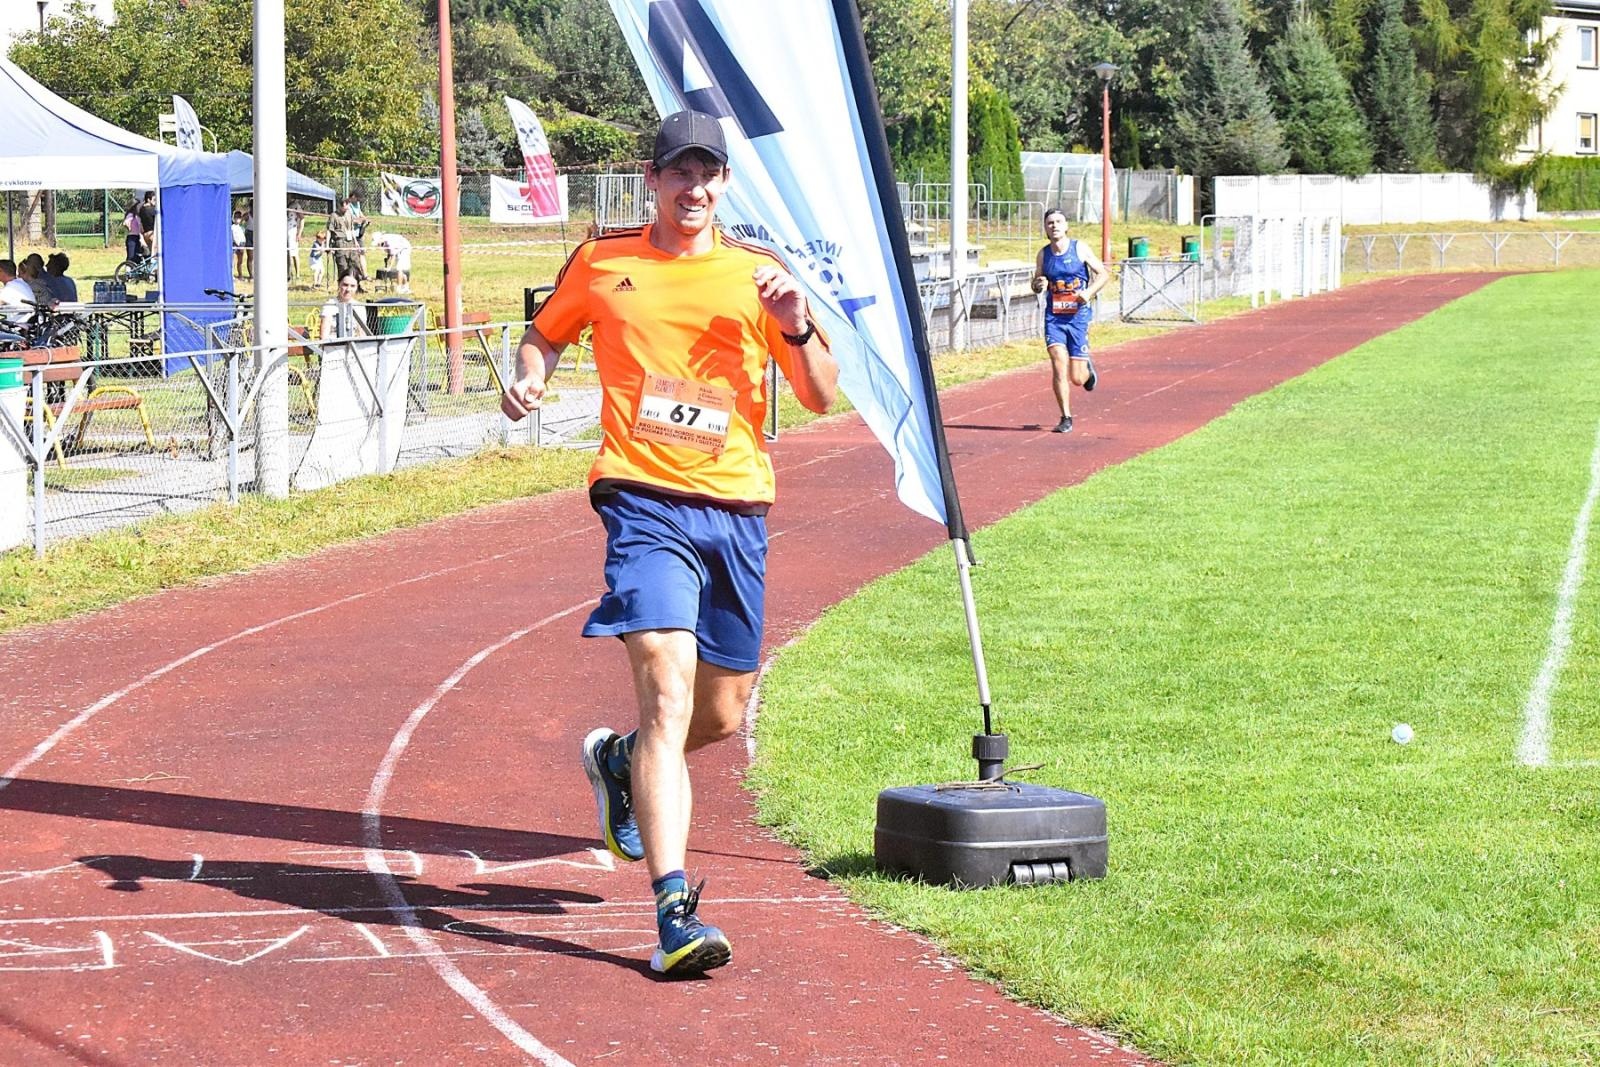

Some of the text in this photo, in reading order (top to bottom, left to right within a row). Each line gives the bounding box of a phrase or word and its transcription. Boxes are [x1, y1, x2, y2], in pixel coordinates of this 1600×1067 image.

[669, 404, 702, 426] 67
[641, 427, 663, 436] PUCHAR
[697, 433, 722, 443] WALKING
